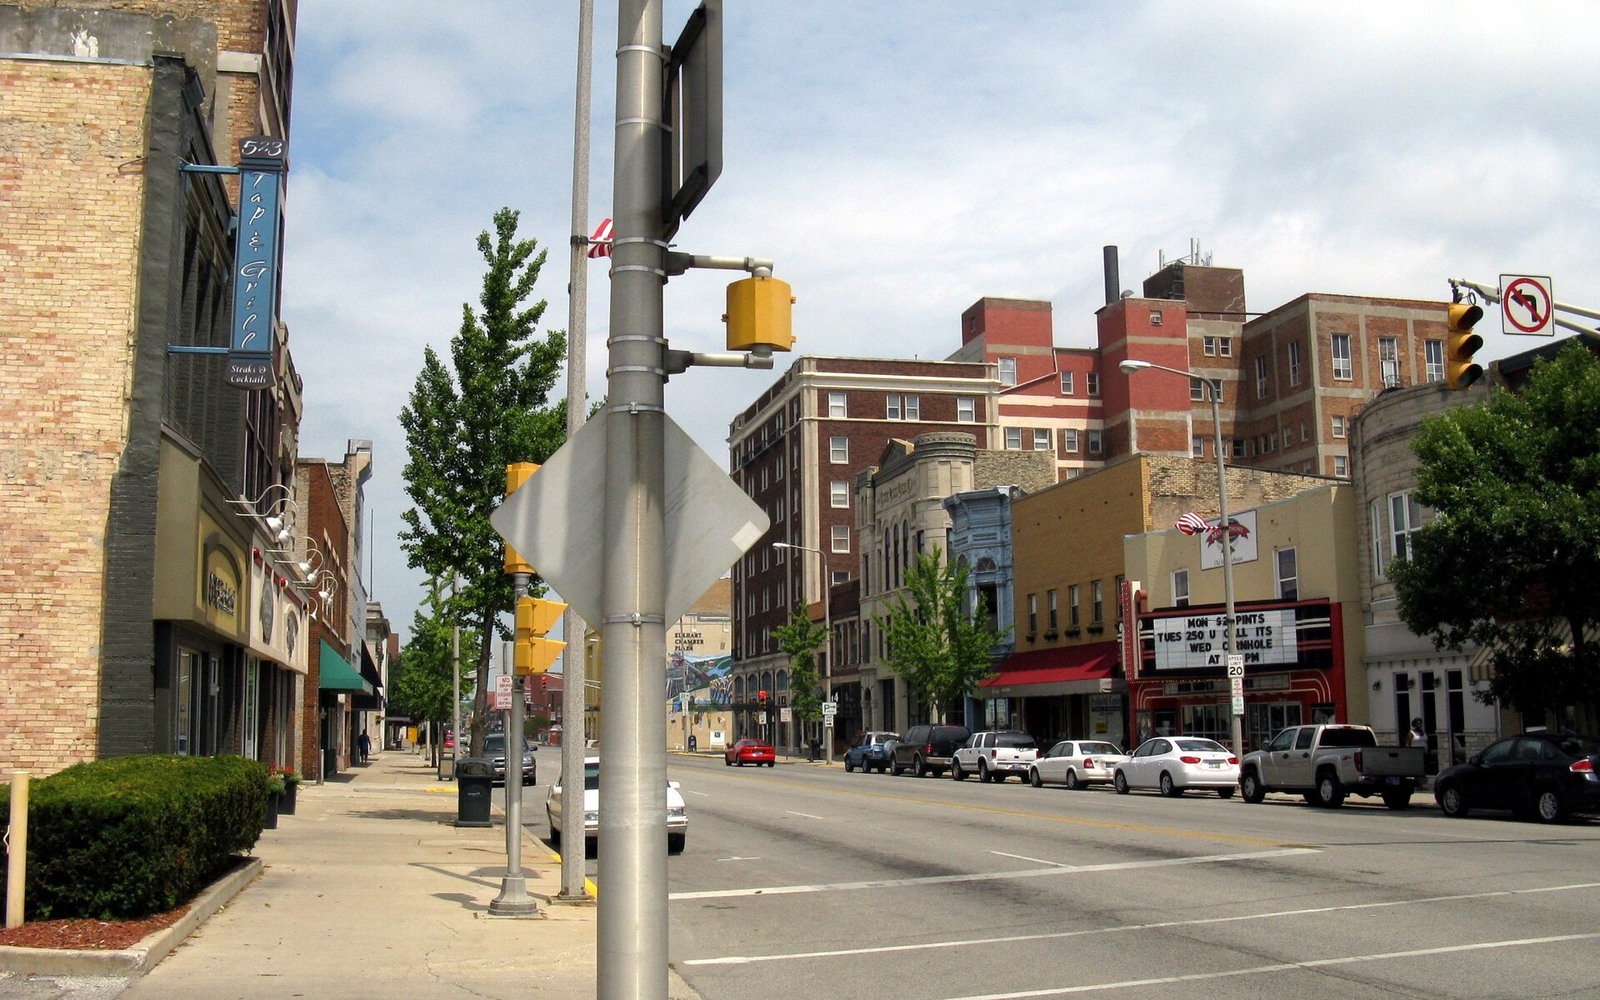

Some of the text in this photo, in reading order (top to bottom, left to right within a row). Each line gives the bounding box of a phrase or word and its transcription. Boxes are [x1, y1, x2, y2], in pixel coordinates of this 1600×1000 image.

[241, 140, 282, 156] 523
[248, 171, 272, 226] Tap
[240, 260, 268, 349] Grill
[231, 364, 256, 373] Steaks
[230, 375, 267, 383] Cocktails
[1187, 617, 1208, 628] MON
[1235, 613, 1265, 625] PINTS
[1157, 625, 1273, 642] TUES 250 U CLL ITS
[1189, 638, 1273, 653] WED CRNHOLE
[1208, 652, 1260, 665] AT PM
[1229, 666, 1243, 676] 20
